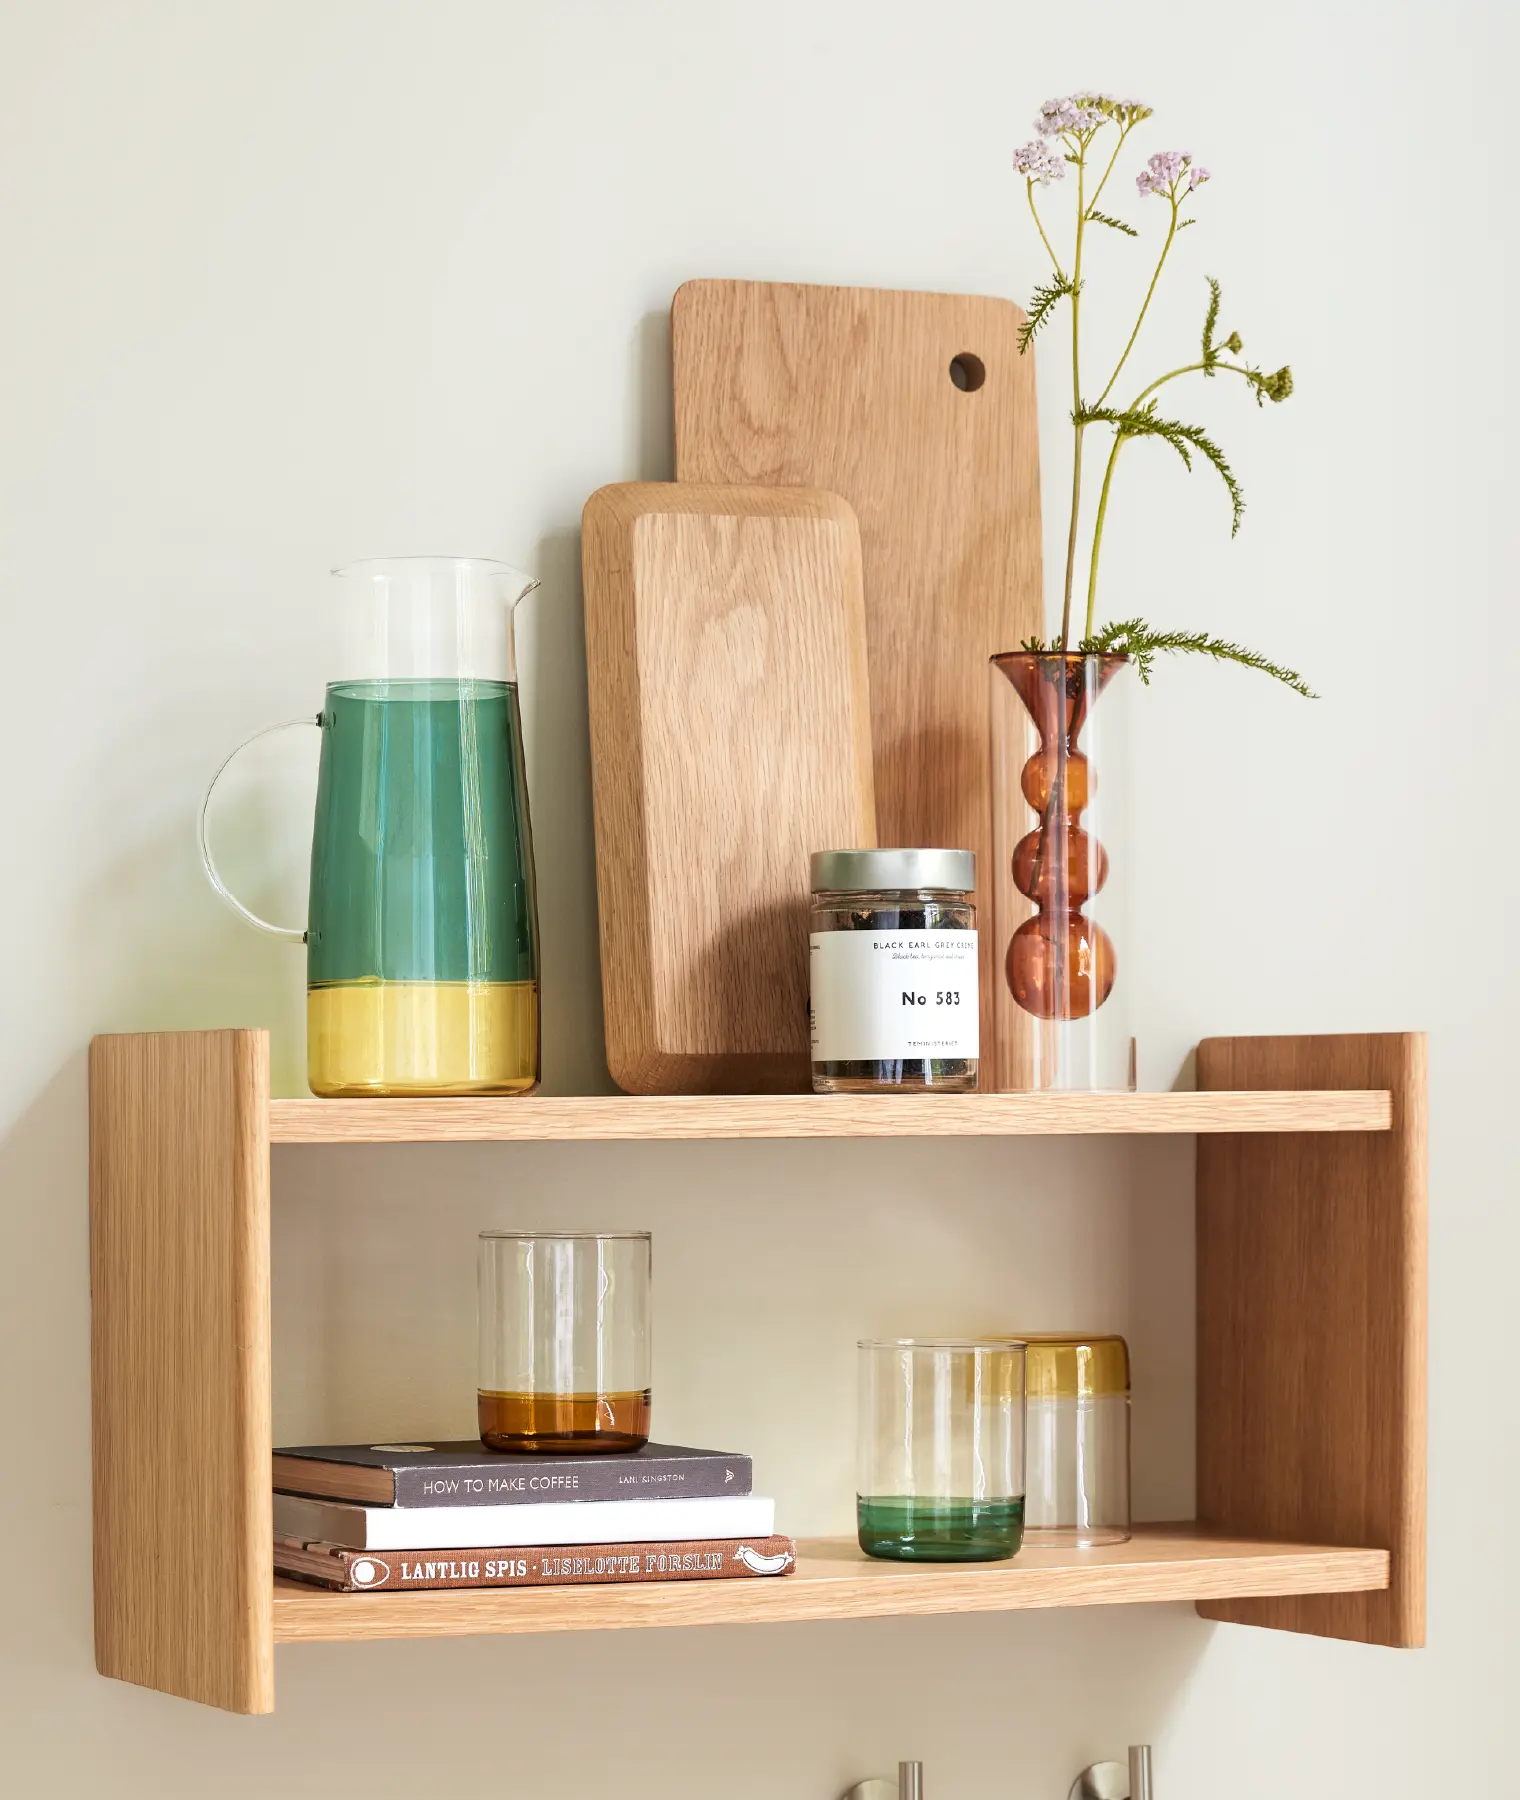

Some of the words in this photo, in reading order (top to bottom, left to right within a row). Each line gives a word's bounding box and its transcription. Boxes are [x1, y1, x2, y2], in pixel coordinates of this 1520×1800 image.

[873, 942, 904, 950] BLACK
[908, 941, 931, 949] EARL
[934, 941, 955, 949] GREY
[902, 991, 927, 1006] No
[935, 991, 961, 1006] 583
[423, 1479, 460, 1495] HOW
[463, 1479, 484, 1493] TO
[488, 1477, 526, 1492] MAKE
[529, 1475, 579, 1490] COFFEE
[619, 1475, 639, 1484] LANI
[641, 1473, 685, 1483] KINGSTON
[401, 1561, 480, 1580] LANTLIG
[484, 1559, 527, 1578] SPIS
[541, 1556, 640, 1576] LISELOTTE
[645, 1552, 723, 1572] FORSLIN
